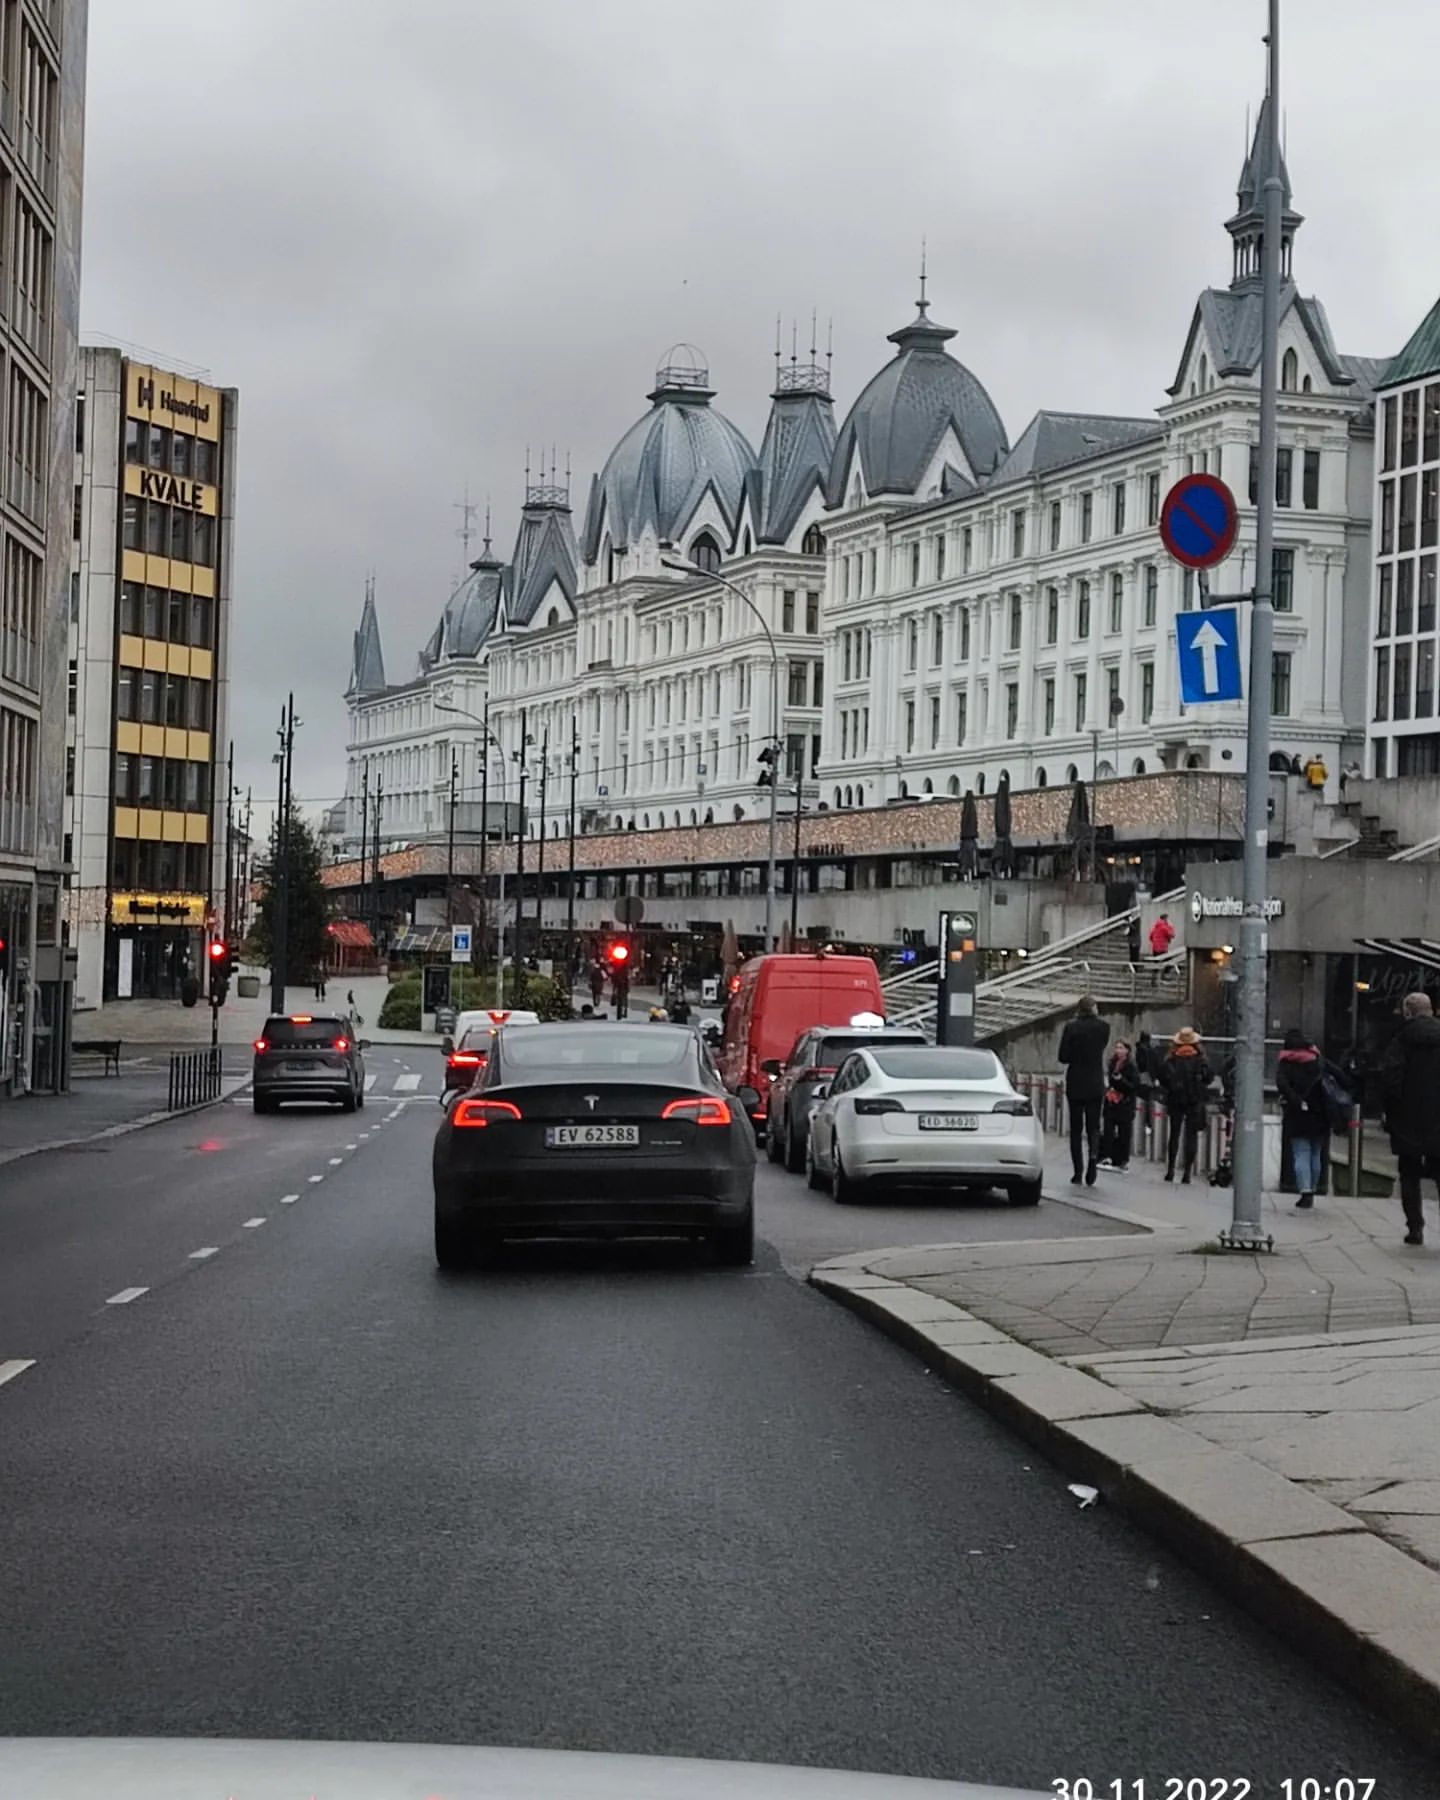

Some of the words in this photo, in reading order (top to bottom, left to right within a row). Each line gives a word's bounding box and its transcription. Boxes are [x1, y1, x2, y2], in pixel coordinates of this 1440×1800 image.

[141, 470, 203, 509] KVALE
[559, 1128, 578, 1142] EV
[585, 1128, 634, 1141] 62588
